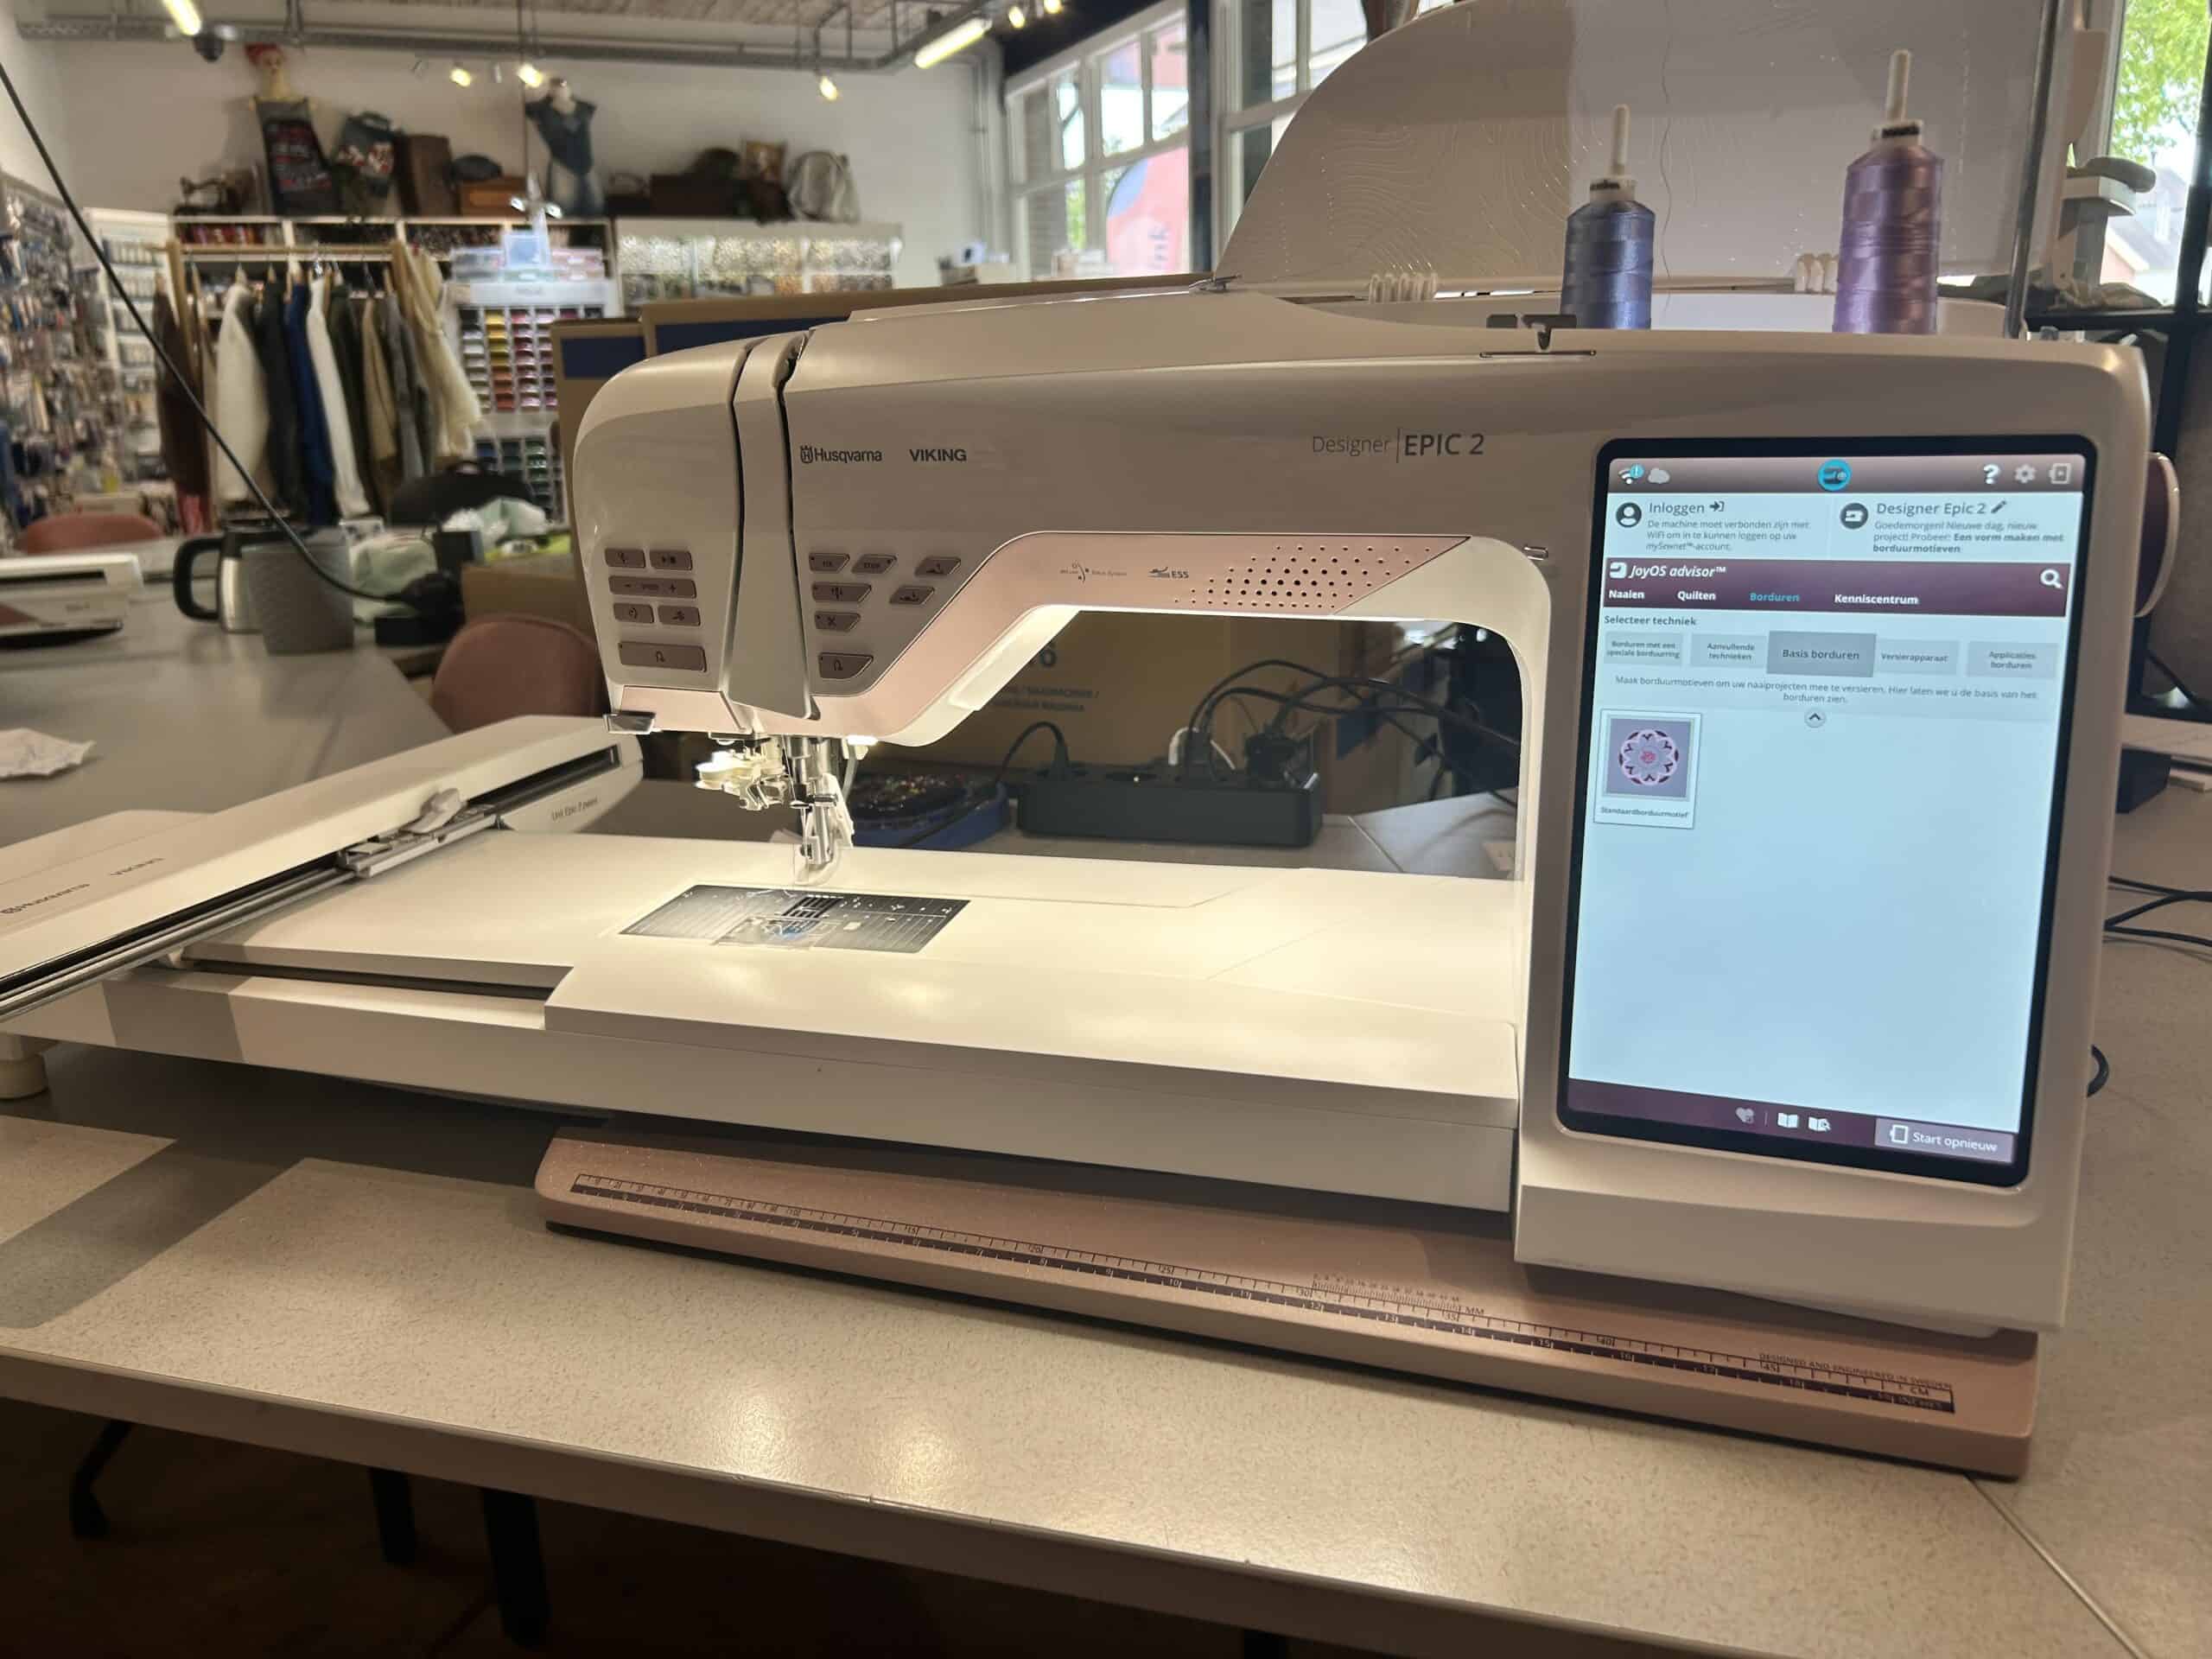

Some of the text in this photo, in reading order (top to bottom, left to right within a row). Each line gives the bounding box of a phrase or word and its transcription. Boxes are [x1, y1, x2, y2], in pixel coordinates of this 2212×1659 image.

[1313, 433, 1484, 457] Designer EPIC 2
[814, 447, 967, 464] Husqvarna VIKING
[1649, 502, 1705, 516] Inloggen
[1876, 502, 1986, 517] Designer Epic 2
[1662, 520, 1698, 529] machine
[1725, 520, 1771, 529] verbonden
[1774, 521, 1789, 531] zijn
[1874, 521, 1945, 531] Goedemorgen!
[1946, 521, 1983, 530] Nieuwe
[1703, 531, 1736, 540] kunnen
[1738, 531, 1767, 542] loggen
[1769, 533, 1781, 542] op
[2004, 533, 2040, 542] maken
[1873, 544, 1961, 553] borduurmotieven
[1171, 570, 1189, 579] ESS
[1629, 564, 1667, 579] JoyOS
[1609, 589, 1919, 605] Naaien Quilten Borduren Kenniscentrum
[1604, 615, 1697, 626] Selecteer techniek
[1707, 642, 1756, 652] Aanvullende
[1708, 652, 1752, 661] technieken
[1782, 648, 1859, 661] Basis borduren
[1881, 652, 1948, 664] Versierapparaat
[1990, 660, 2032, 670] borduren
[1615, 675, 1638, 684] Maak
[1640, 677, 1714, 688] borduurmotieven
[1747, 681, 1808, 692] naaiprojecten
[1888, 685, 1908, 694] Hier
[1910, 687, 1933, 696] laten
[1974, 690, 1999, 698] basis
[1783, 693, 1825, 702] borduren
[1912, 1131, 1999, 1153] Start opnieuw
[1299, 1287, 1310, 1297] 30
